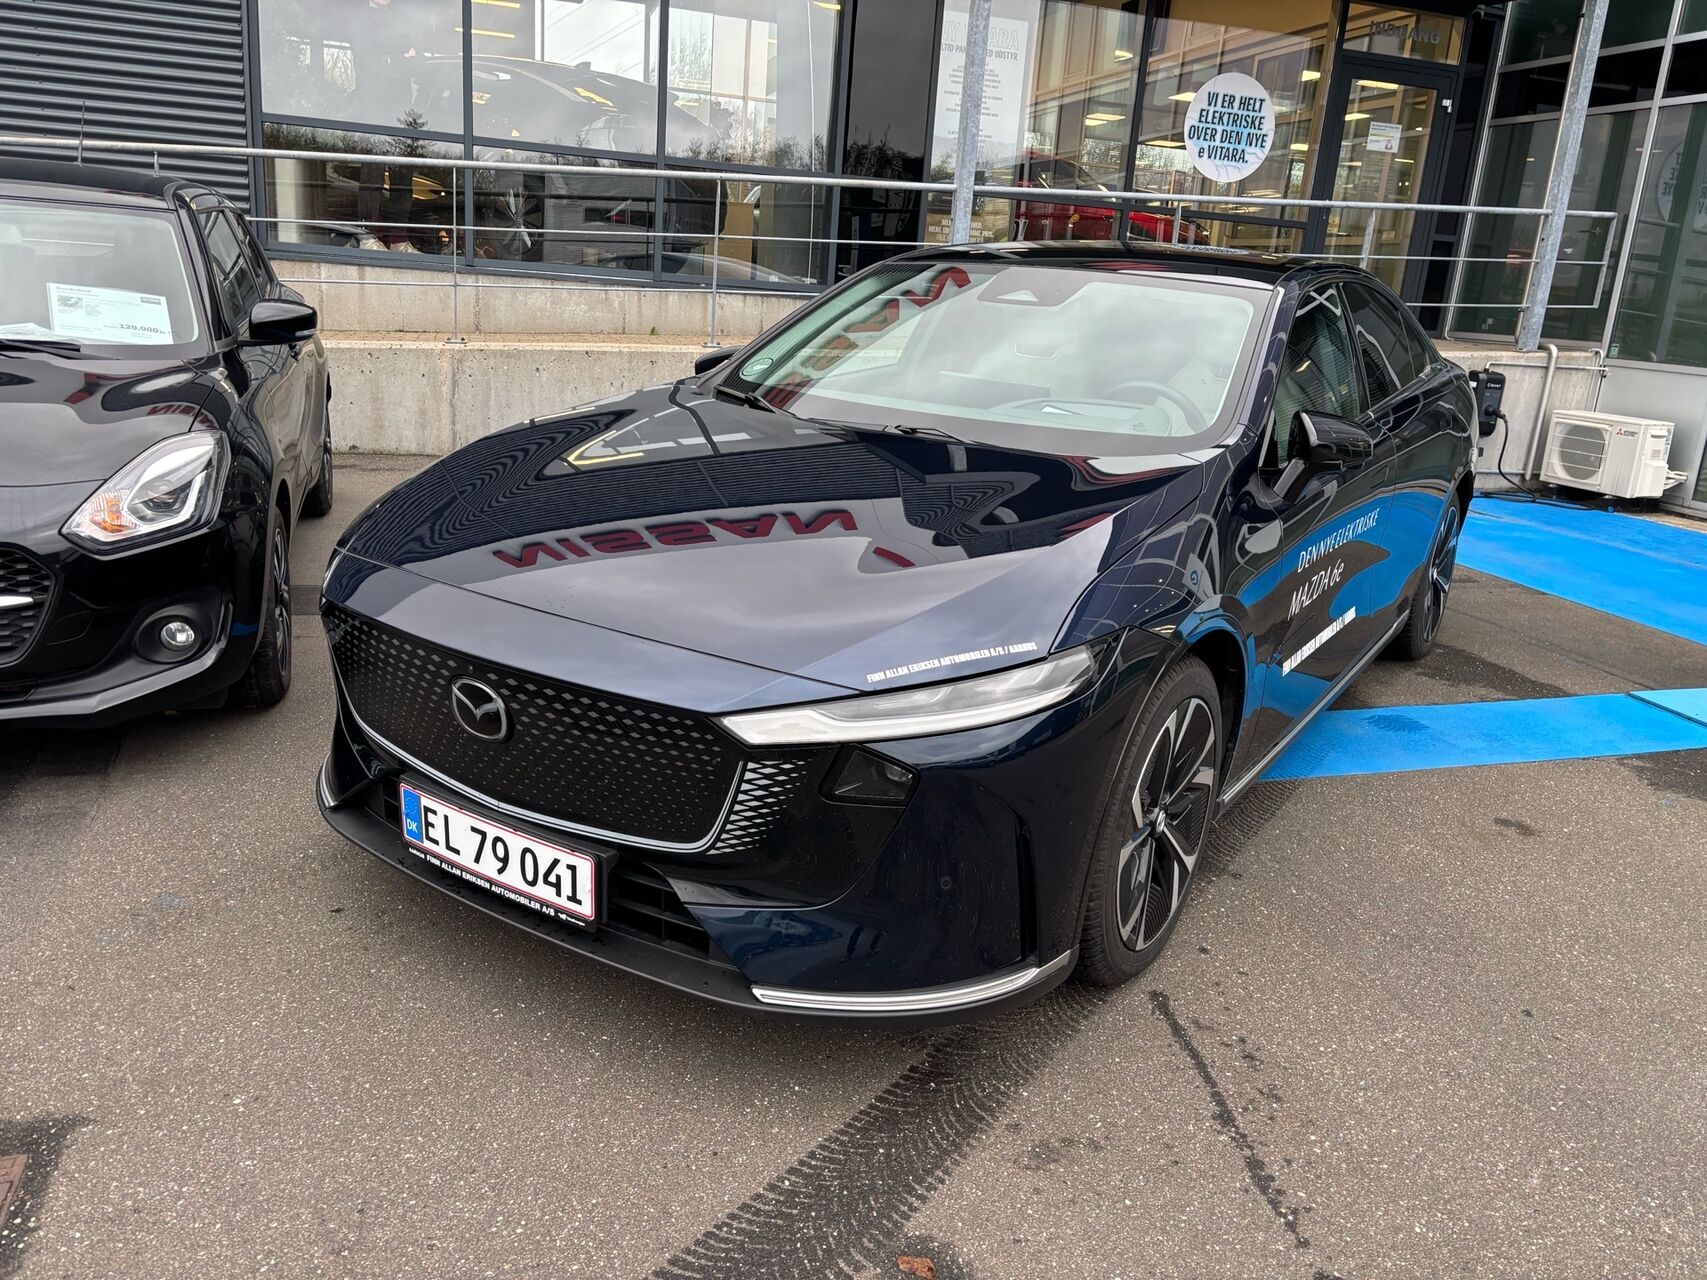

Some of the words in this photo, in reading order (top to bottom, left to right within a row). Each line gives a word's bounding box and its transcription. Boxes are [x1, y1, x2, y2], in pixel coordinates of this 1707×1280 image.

[1207, 91, 1219, 107] VI
[1221, 94, 1236, 110] ER
[1238, 95, 1266, 113] HELT
[1198, 108, 1266, 131] ELEKTRISKE
[1188, 125, 1218, 142] OVER
[1220, 129, 1243, 145] DEN
[1245, 132, 1268, 148] NYE
[1198, 146, 1205, 158] e
[1207, 144, 1248, 164] VITARA.
[1297, 543, 1319, 573] DEN
[1318, 532, 1337, 559] NYE
[1335, 508, 1380, 549] ELEKTRISKE
[1288, 566, 1331, 621] MAZDA
[1330, 558, 1345, 587] 6e
[406, 818, 418, 833] DK
[423, 804, 461, 856] EL
[470, 825, 510, 875] 79
[520, 847, 583, 906] 041
[426, 854, 441, 867] FINN
[441, 861, 461, 877] ALLAN
[462, 871, 490, 890] ERIKSEN
[491, 884, 541, 911] AUTOMOBILER
[542, 905, 555, 917] A/S
